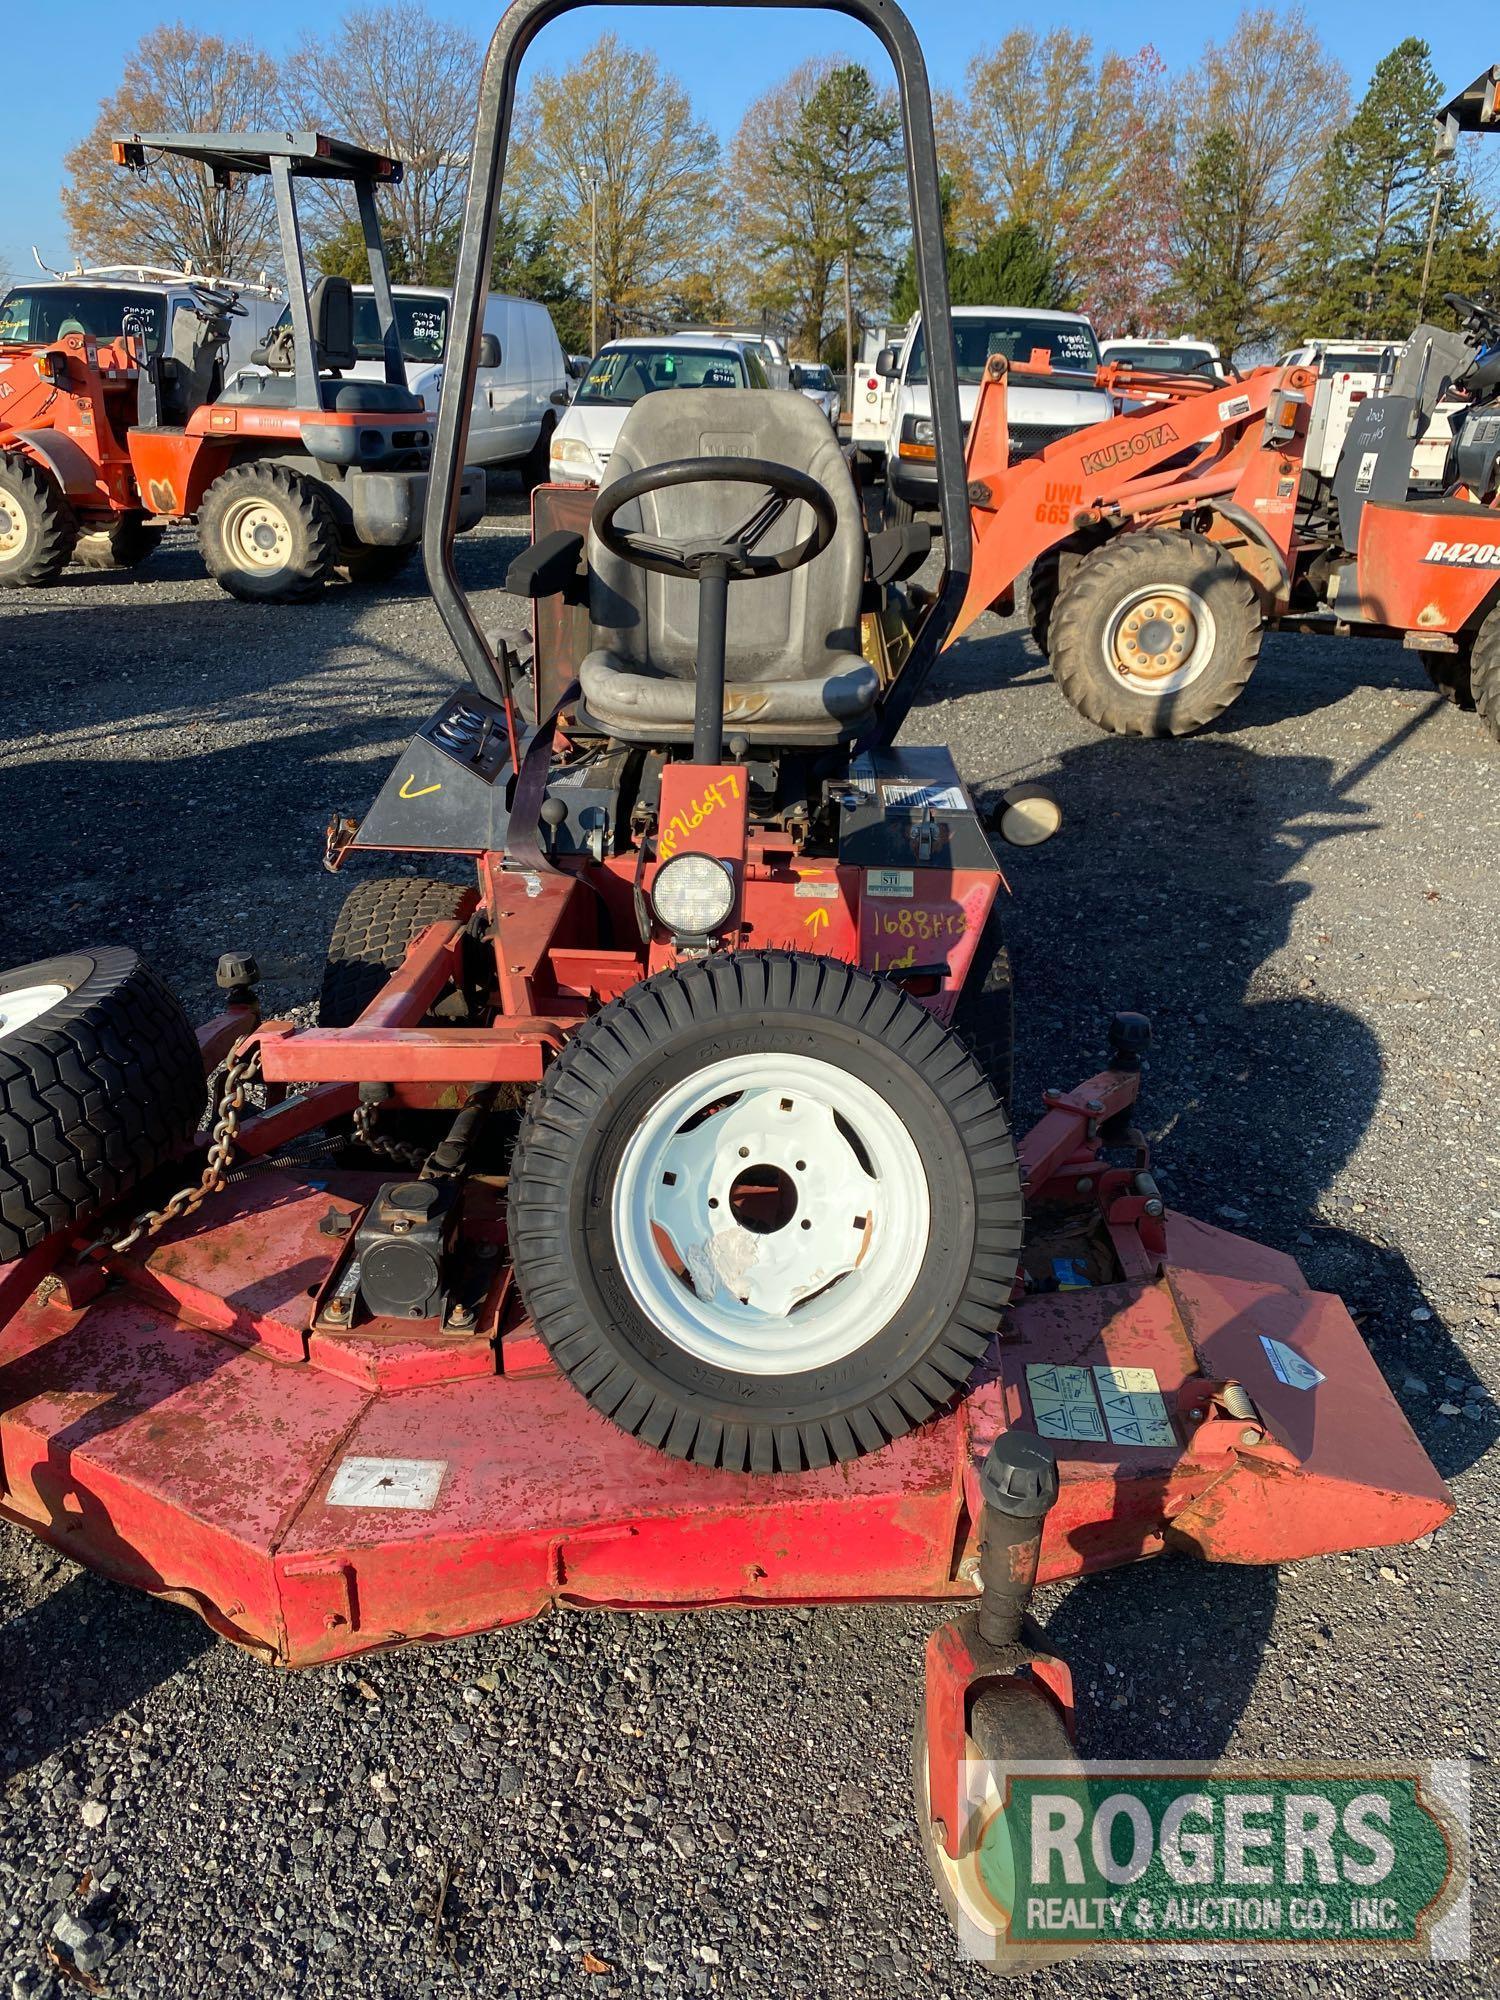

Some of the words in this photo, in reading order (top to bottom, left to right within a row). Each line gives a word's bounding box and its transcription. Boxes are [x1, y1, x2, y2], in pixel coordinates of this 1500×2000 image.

[1080, 423, 1179, 476] KUBOTA
[1045, 482, 1084, 505] UWL
[1036, 503, 1070, 524] 665
